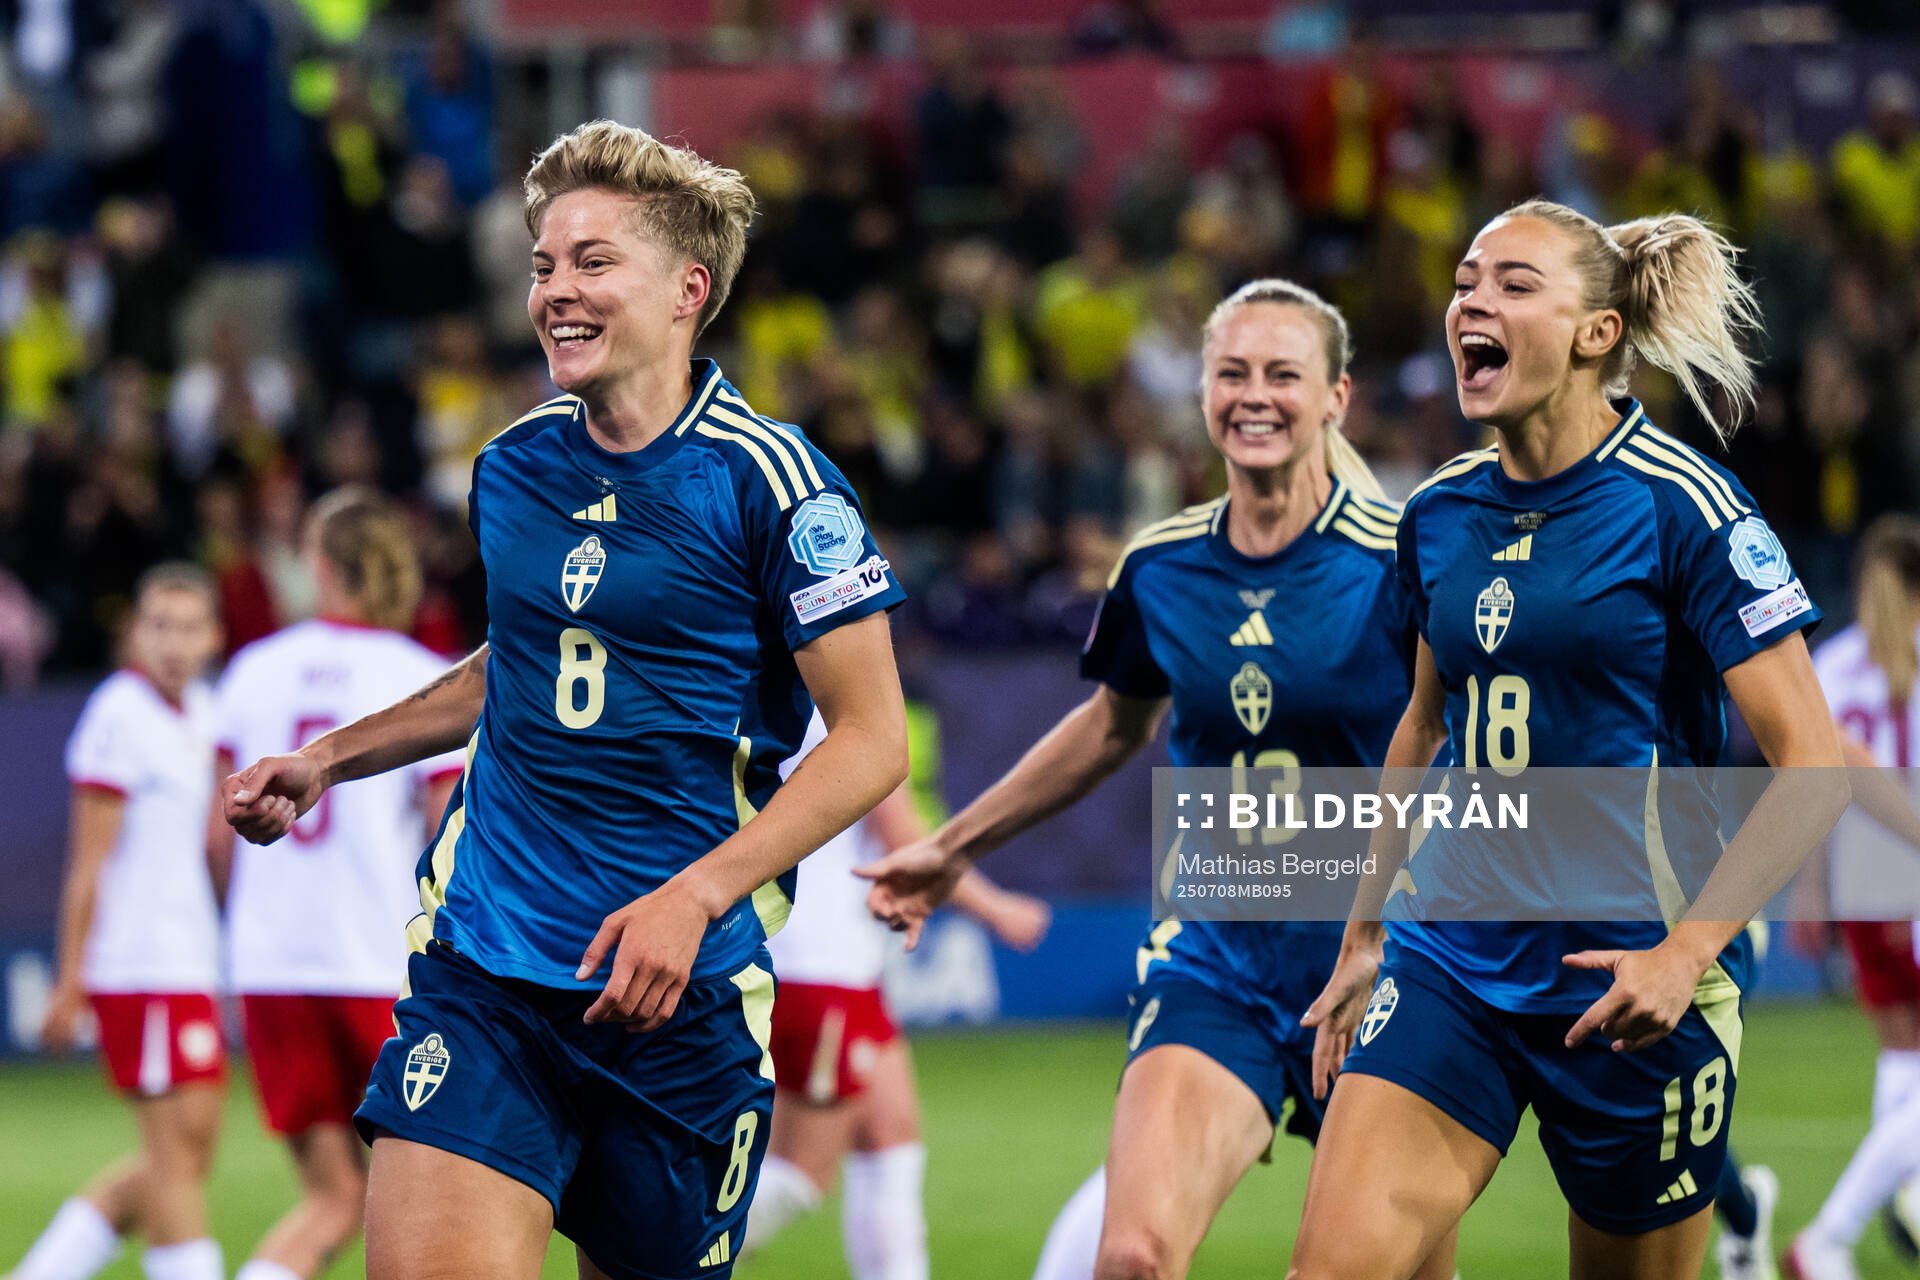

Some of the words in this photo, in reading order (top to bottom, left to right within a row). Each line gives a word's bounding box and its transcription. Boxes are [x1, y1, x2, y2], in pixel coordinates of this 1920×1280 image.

[815, 531, 834, 543] Play
[818, 535, 846, 551] Strong
[796, 581, 860, 613] FOUNDATION
[555, 627, 608, 730] 8
[1465, 673, 1531, 778] 18
[1231, 748, 1305, 846] 13
[415, 1056, 442, 1064] SVERIGE
[1660, 1056, 1726, 1161] 18
[716, 1110, 758, 1213] 8
